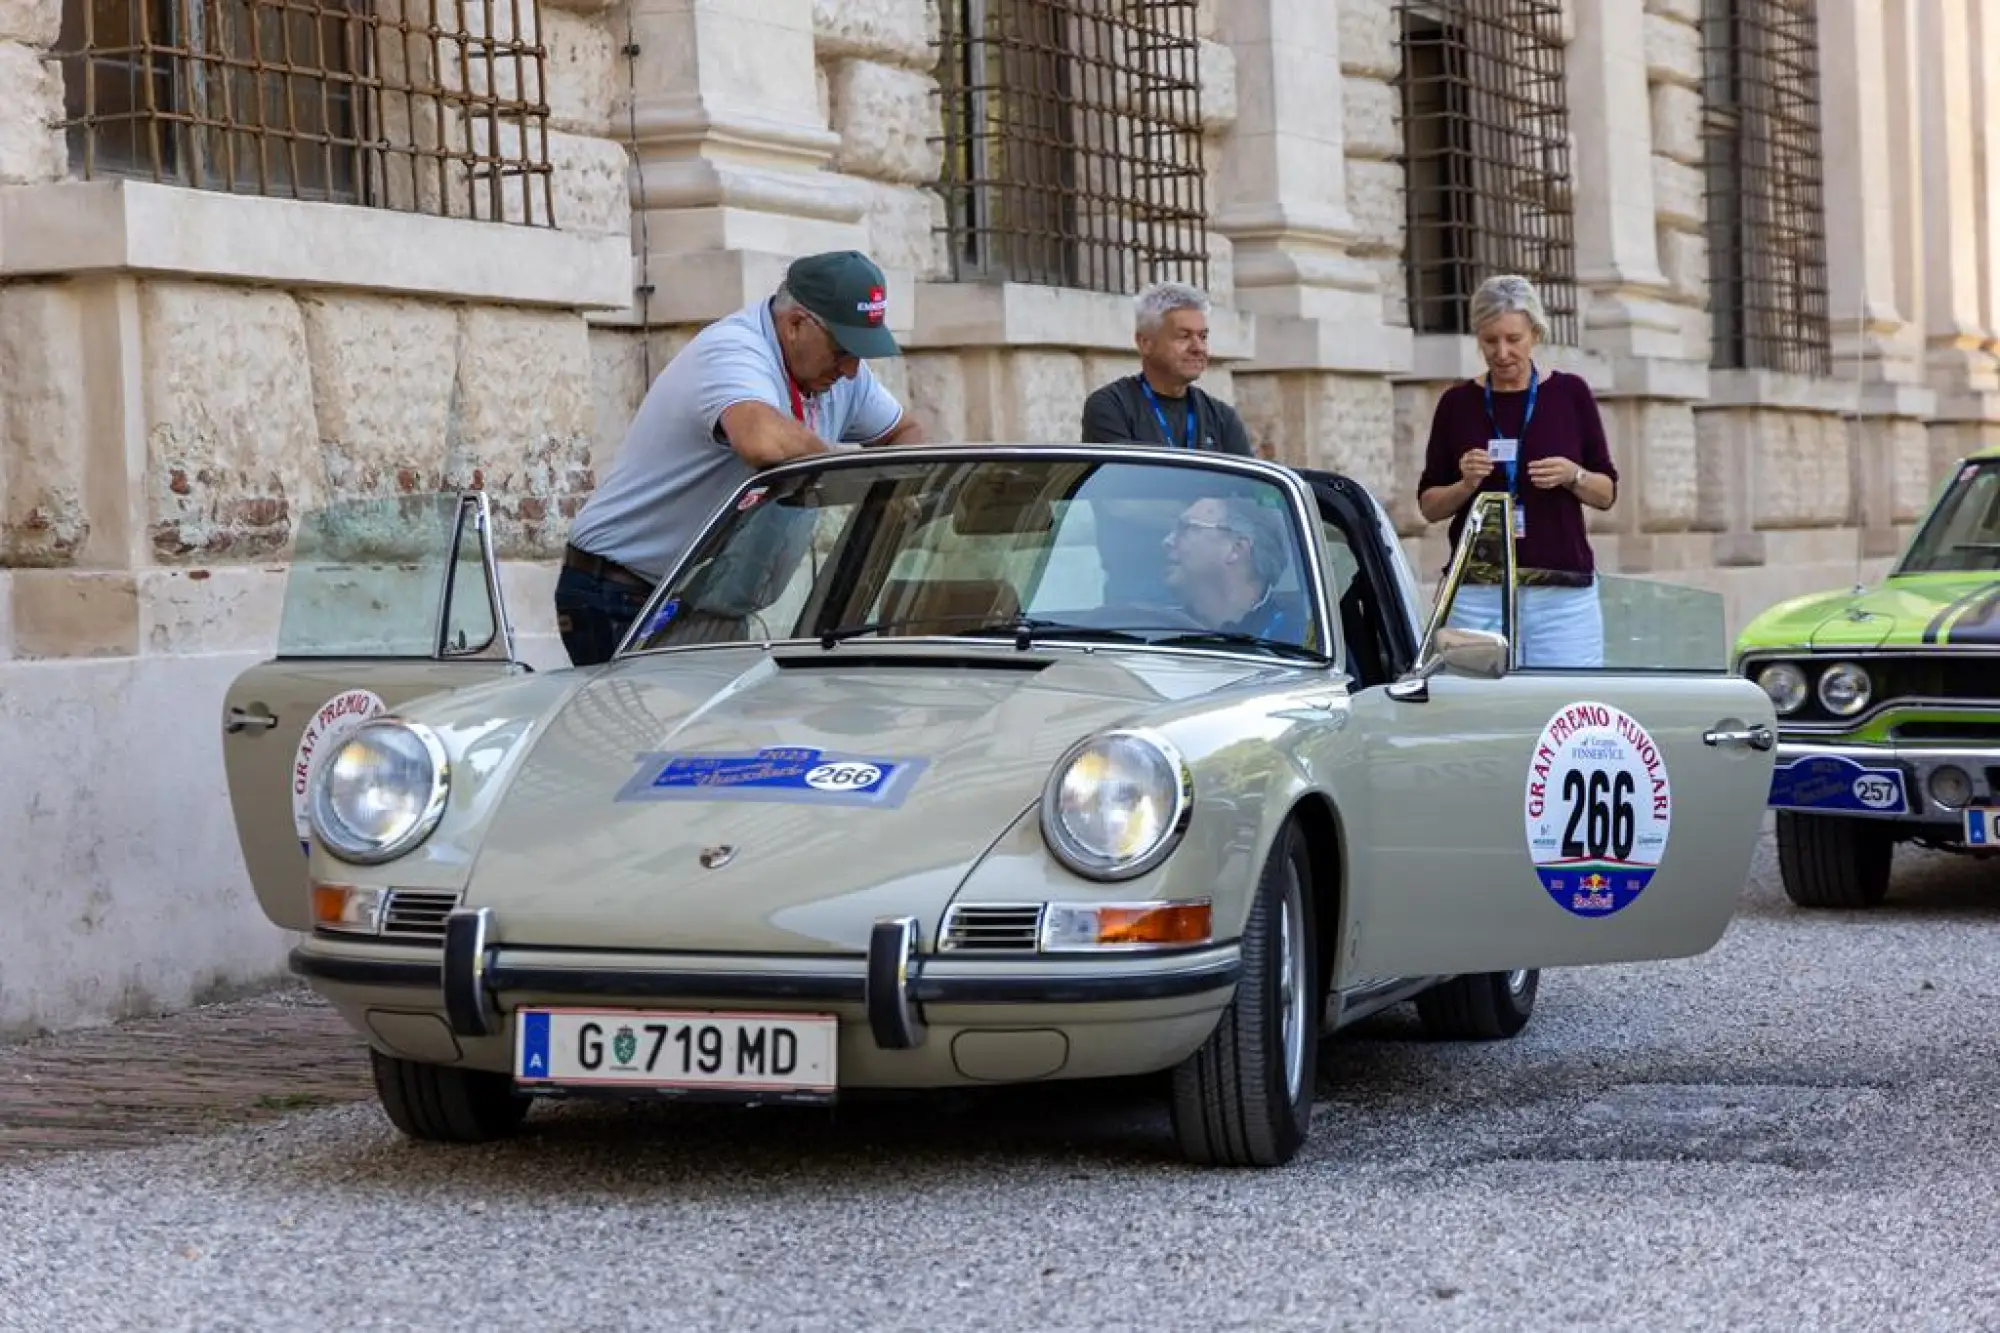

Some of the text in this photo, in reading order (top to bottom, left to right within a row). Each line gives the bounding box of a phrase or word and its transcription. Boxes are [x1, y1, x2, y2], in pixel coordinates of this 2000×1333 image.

[318, 694, 370, 731] PREMIO
[811, 766, 877, 786] 266
[1528, 705, 1668, 821] GRAN PREMIO NUVOLARI
[1856, 780, 1894, 801] 257
[1560, 768, 1636, 860] 266
[529, 1053, 542, 1068] A
[578, 1022, 798, 1076] G 719 MD
